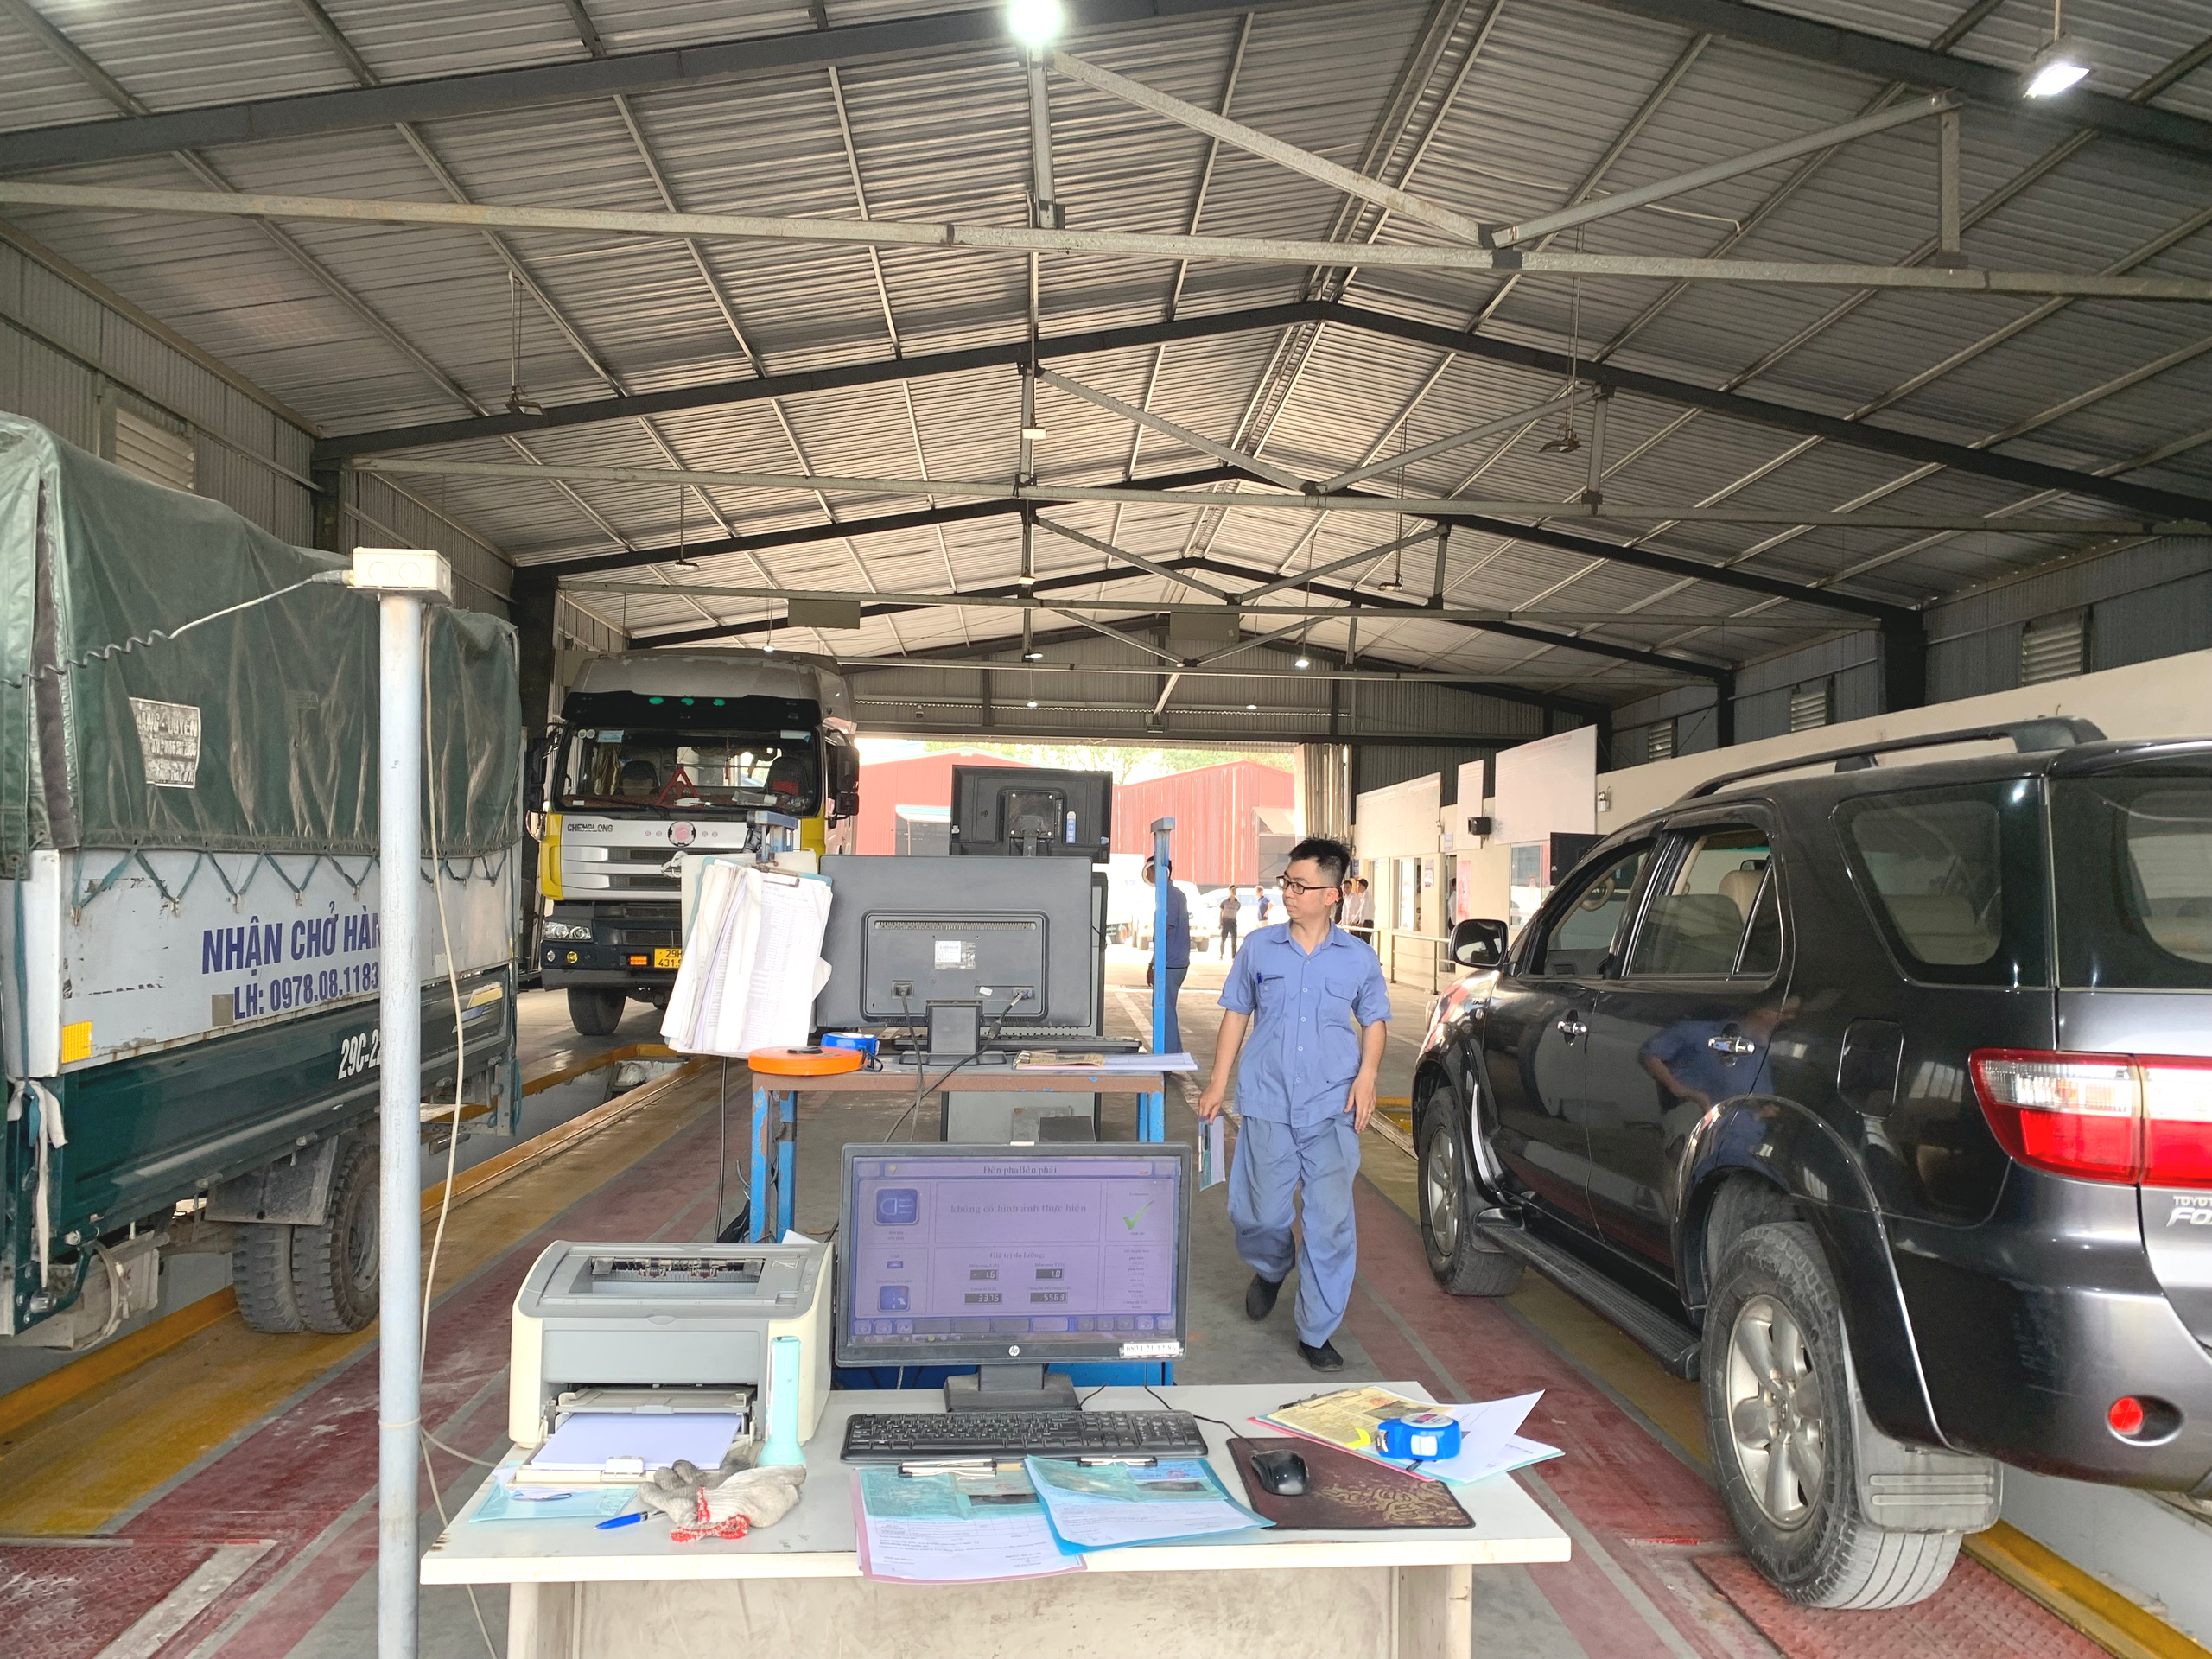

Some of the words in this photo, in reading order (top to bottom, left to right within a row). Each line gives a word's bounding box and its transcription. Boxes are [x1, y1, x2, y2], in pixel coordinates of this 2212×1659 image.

[202, 915, 283, 976] NHẬN
[290, 900, 339, 961] CHỞ
[234, 982, 264, 1020] LH:
[270, 961, 379, 1012] 0978.08.1183
[983, 1166, 1001, 1174] Đèn
[2166, 1207, 2212, 1227] FO
[1009, 1345, 1019, 1357] hp
